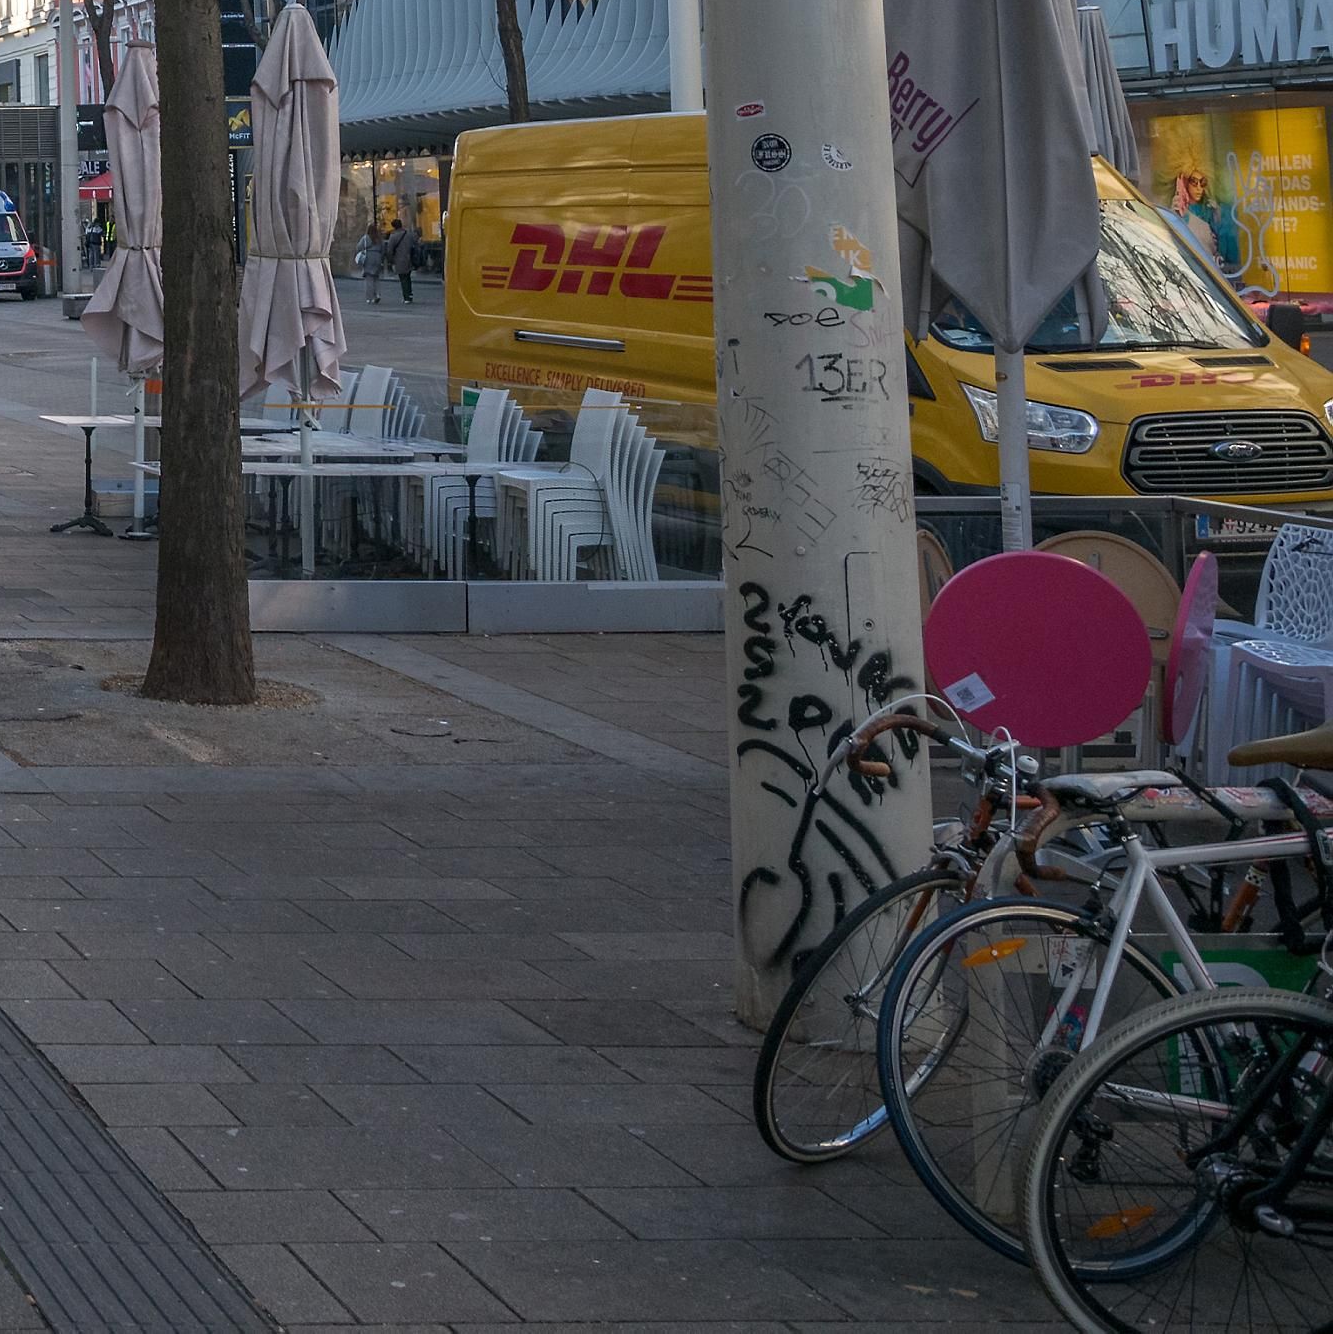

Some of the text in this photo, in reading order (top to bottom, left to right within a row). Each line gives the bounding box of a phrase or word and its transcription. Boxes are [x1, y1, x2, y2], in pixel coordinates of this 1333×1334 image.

[1281, 174, 1312, 191] DAS
[507, 223, 677, 300] DHL
[544, 370, 583, 391] SIMPLY
